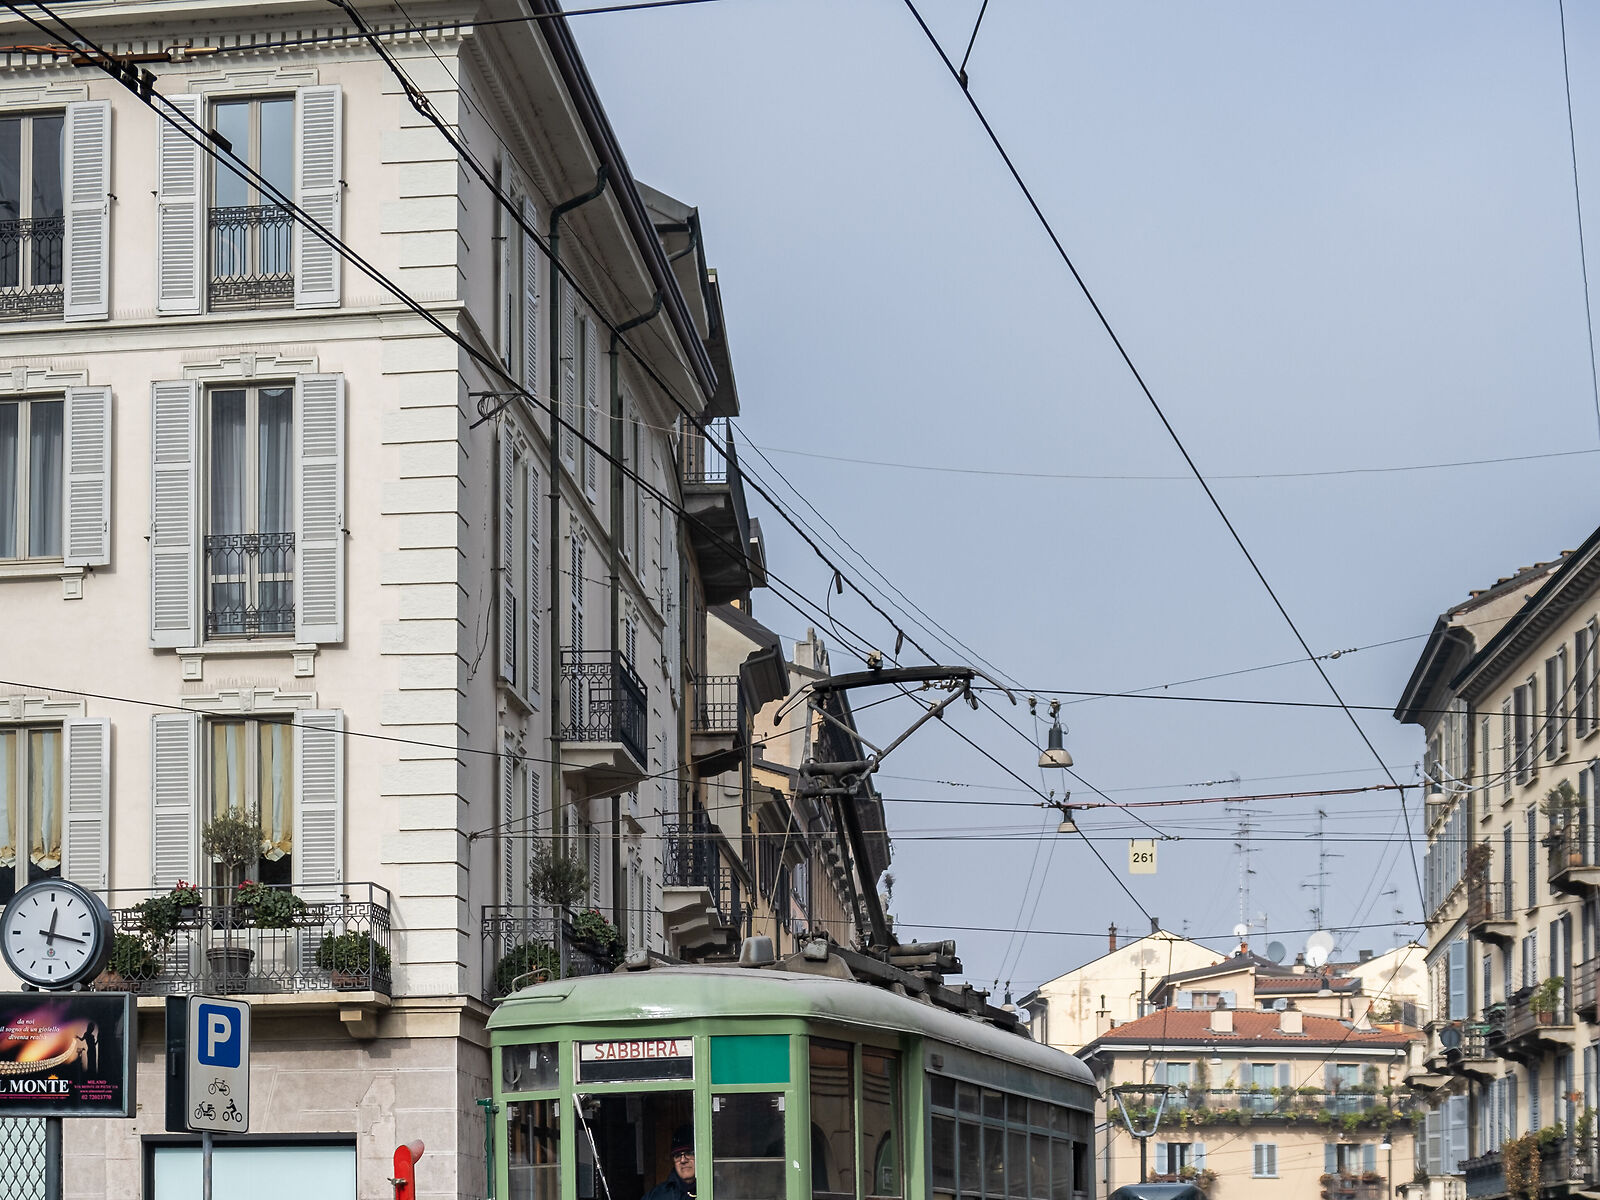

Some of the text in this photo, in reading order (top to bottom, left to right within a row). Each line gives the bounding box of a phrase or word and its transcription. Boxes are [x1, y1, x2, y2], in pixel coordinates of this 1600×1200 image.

[1133, 852, 1154, 863] 261
[207, 1012, 232, 1057] P
[594, 1040, 679, 1060] SABBIERA
[9, 1079, 70, 1093] MONTE
